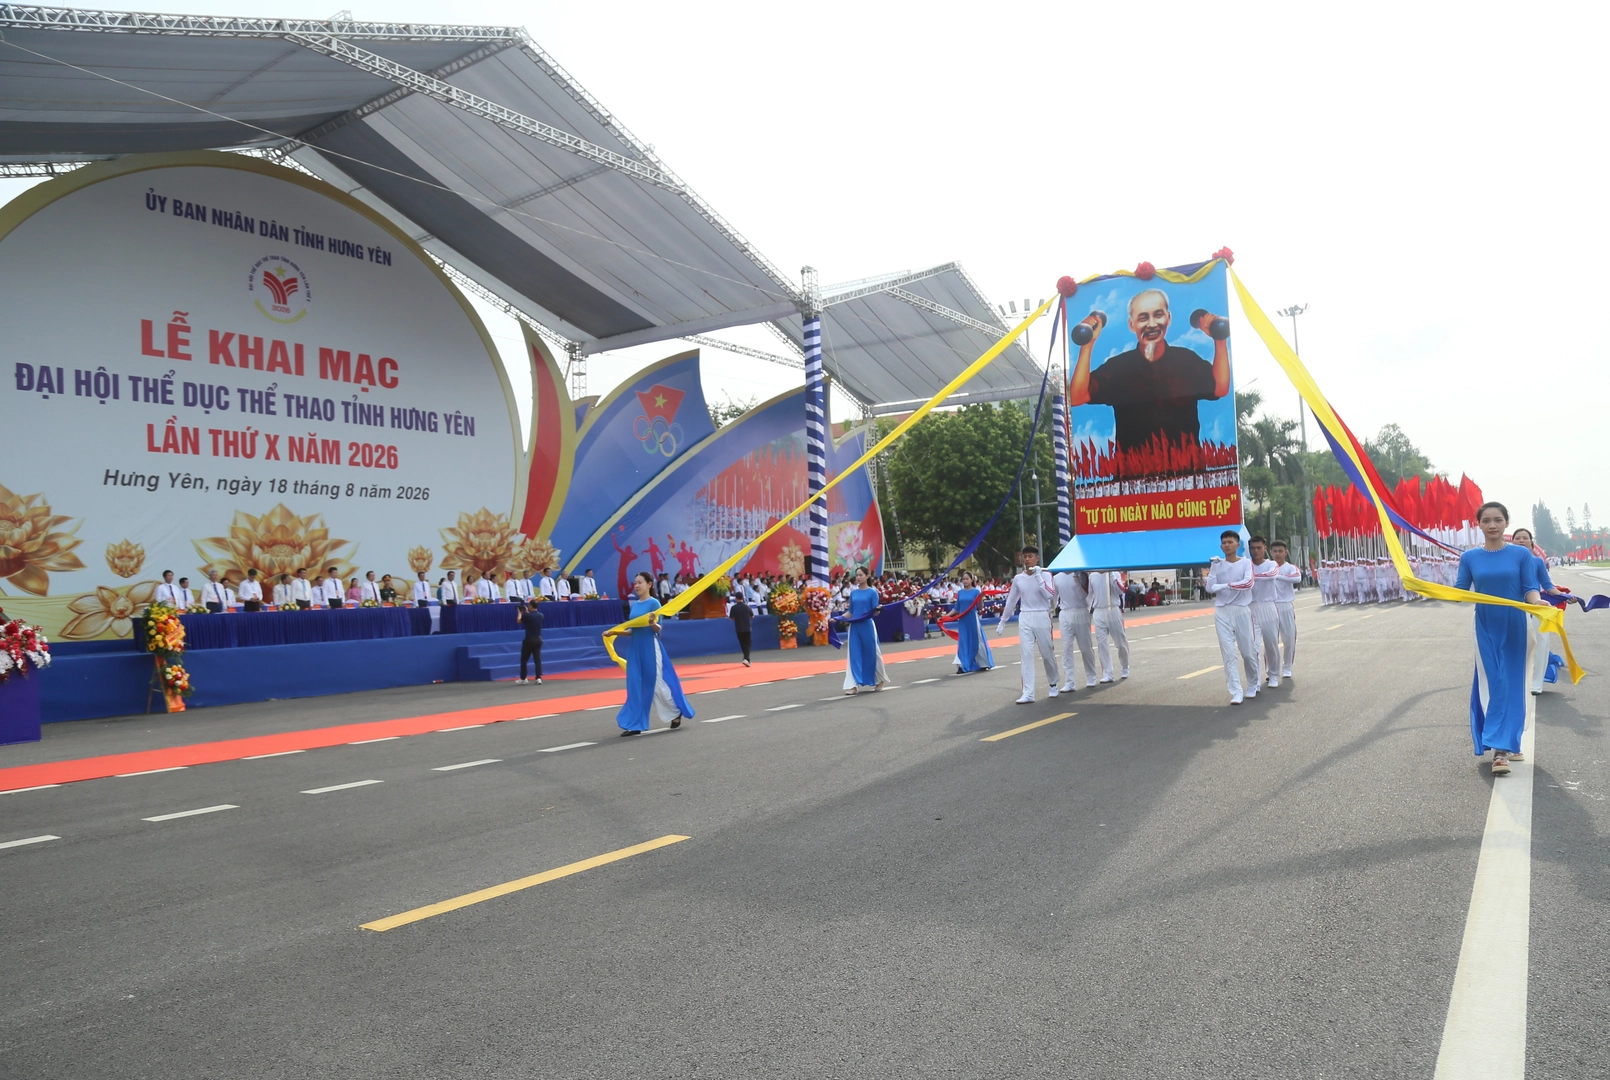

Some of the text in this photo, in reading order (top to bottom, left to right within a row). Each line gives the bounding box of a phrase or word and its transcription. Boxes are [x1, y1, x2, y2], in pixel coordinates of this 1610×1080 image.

[146, 188, 392, 266] ỦY BAN NHÂN DÂN TỈNH HƯNG YÊN
[272, 305, 291, 314] 2026
[141, 310, 399, 392] LỄ KHAI MẠC
[15, 362, 475, 436] ĐẠI HỘI THỂ DỤC THỂ THAO TỈNH HƯNG YÊN
[147, 415, 398, 469] LẦN THỨ X NĂM 2026
[103, 469, 430, 500] Hưng Yên, ngày 18 tháng 8 năm 2026
[1101, 504, 1117, 523] TÔI
[1120, 502, 1148, 522] NGÀY
[1151, 501, 1173, 520] NÀO
[1176, 499, 1207, 518] CŨNG
